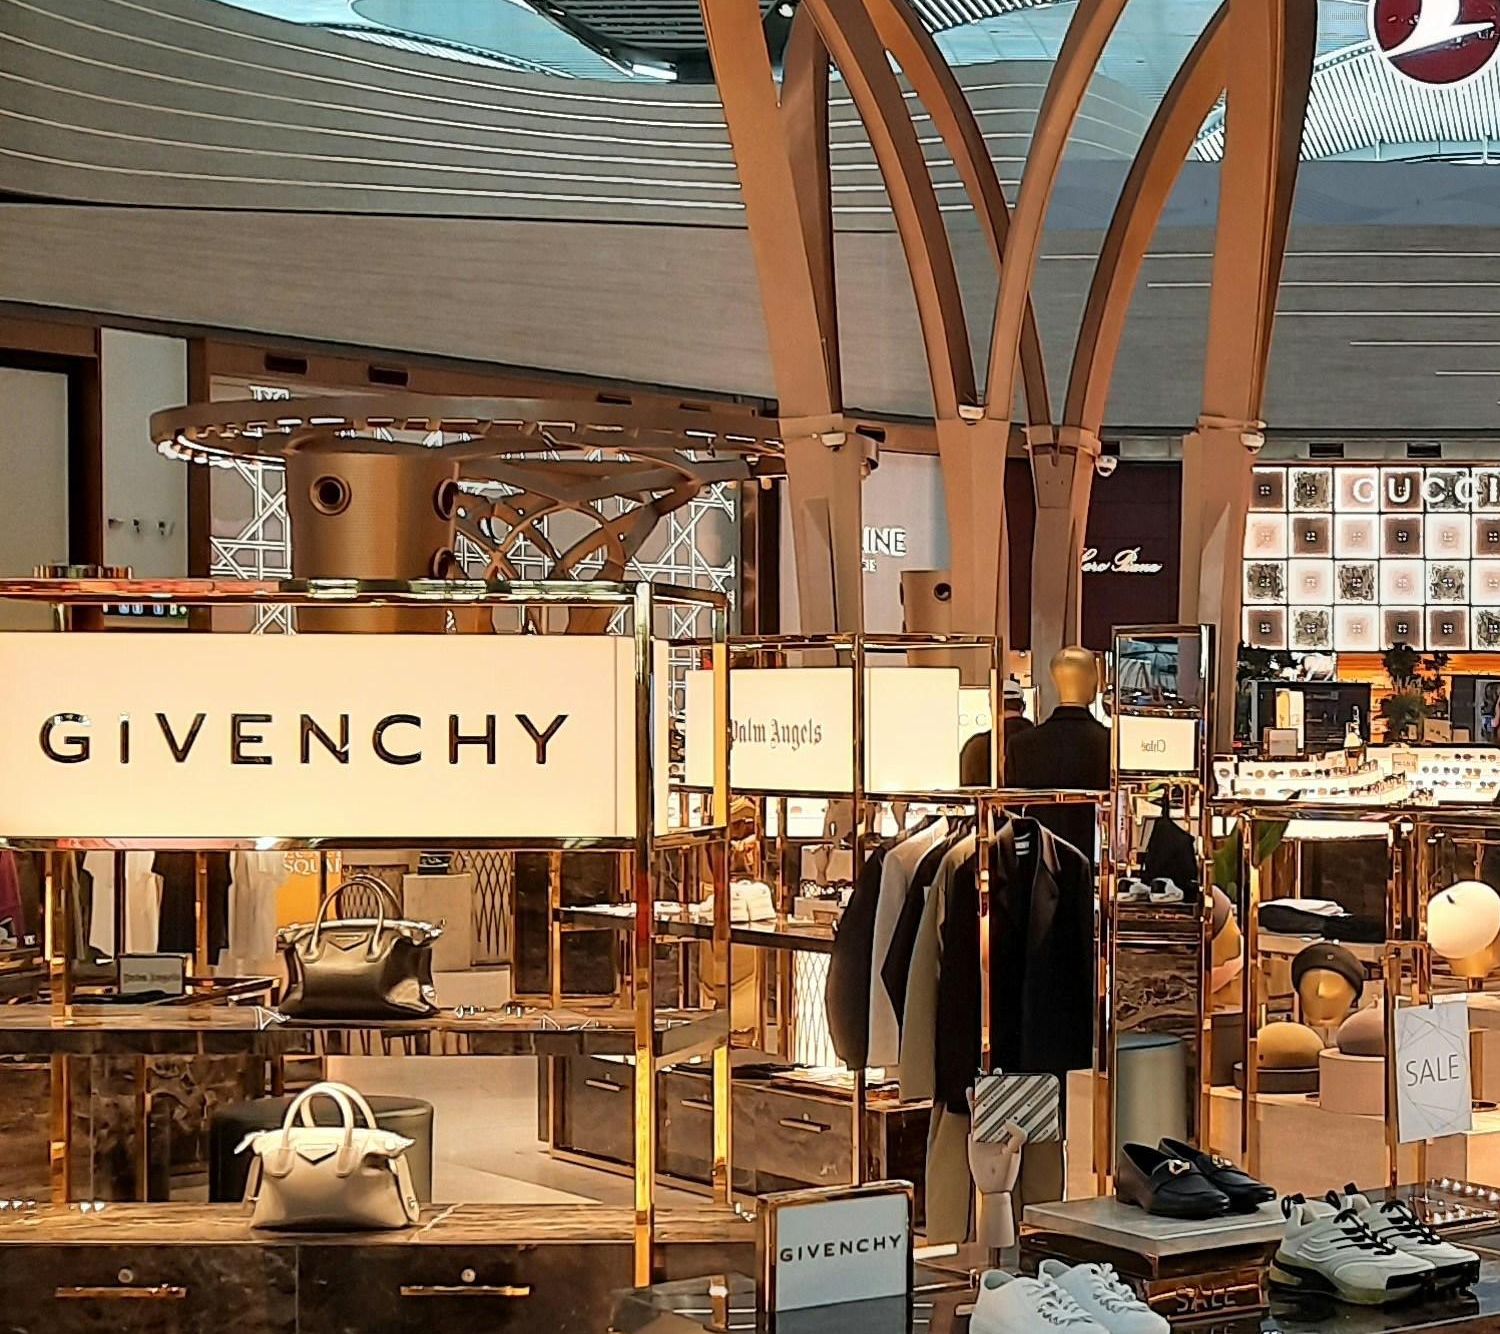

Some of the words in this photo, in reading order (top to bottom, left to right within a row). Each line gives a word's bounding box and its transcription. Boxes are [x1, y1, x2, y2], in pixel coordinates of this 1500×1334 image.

[1352, 476, 1499, 504] GUCCI
[862, 525, 907, 556] INE
[38, 711, 570, 766] GIVENCHY
[730, 717, 766, 747] Palm
[770, 718, 823, 751] Angels
[1404, 1053, 1460, 1088] SALE
[779, 1234, 902, 1262] GIVENCHY
